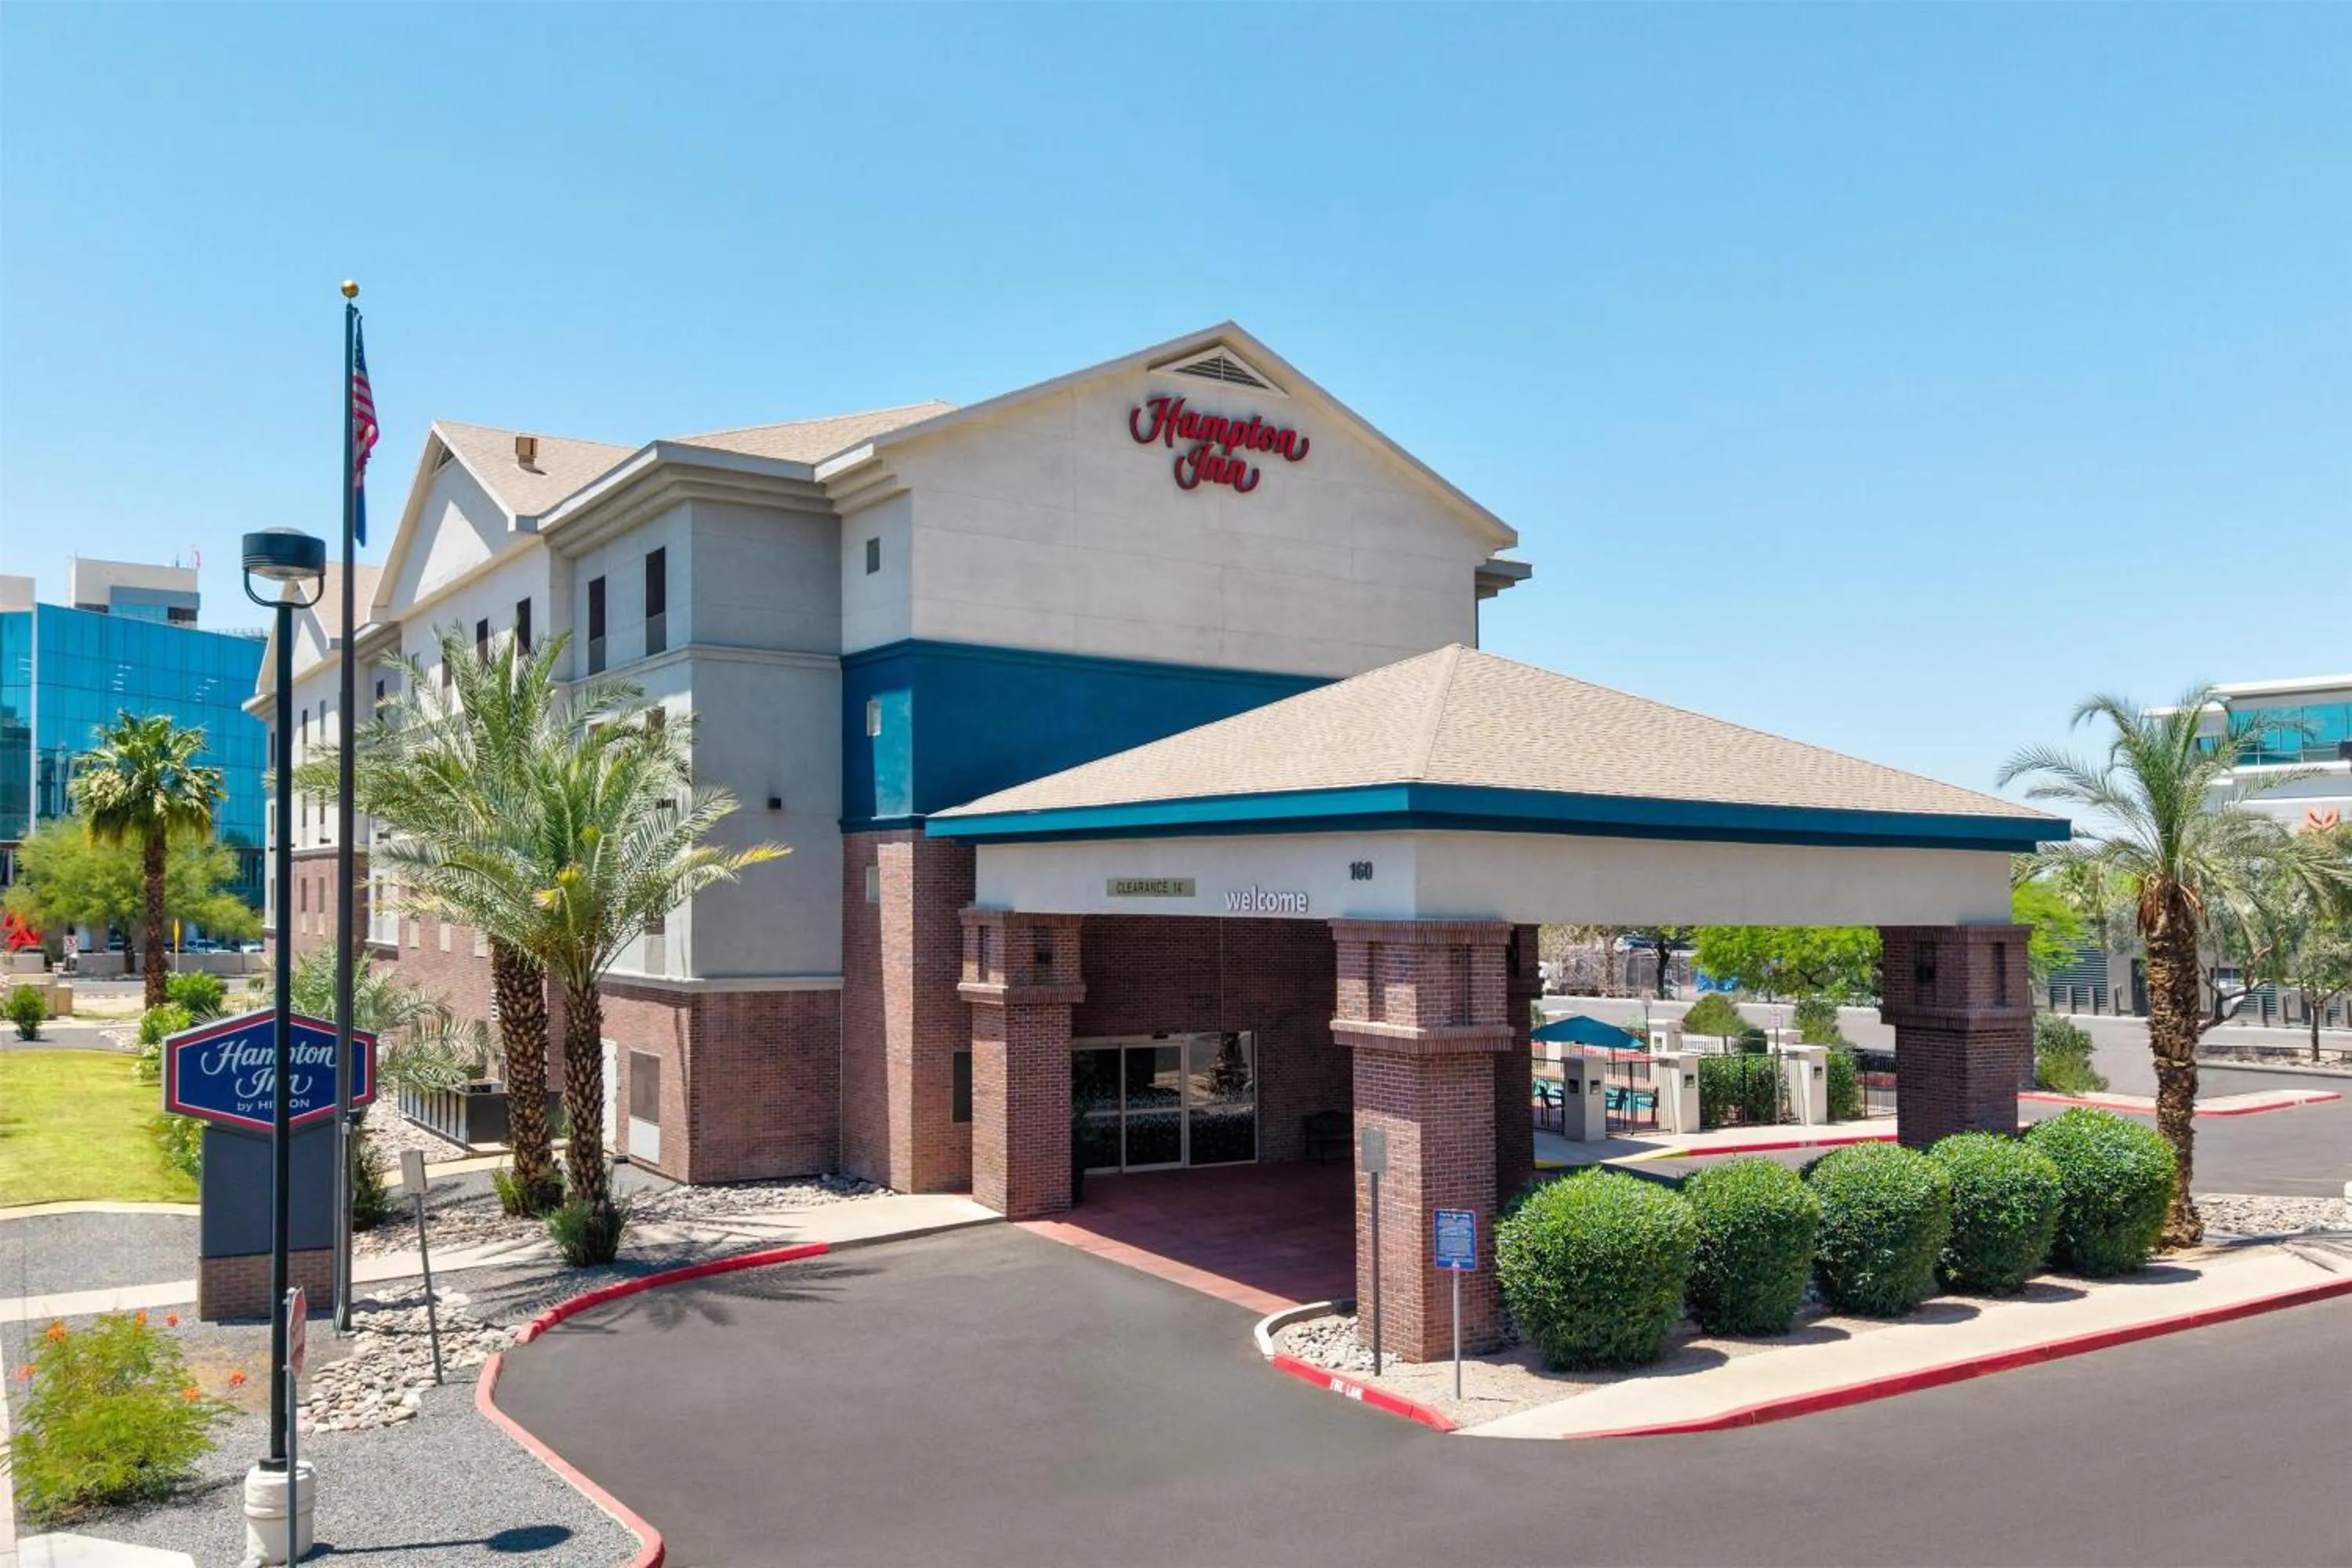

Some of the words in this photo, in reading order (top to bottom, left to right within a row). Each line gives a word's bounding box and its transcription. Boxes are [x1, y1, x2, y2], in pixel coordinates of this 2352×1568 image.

[1129, 396, 1310, 462] Hampton
[1174, 443, 1260, 493] Inn
[1348, 862, 1373, 880] 160
[1116, 880, 1167, 894] CLEARANCE
[1224, 885, 1308, 912] welcome
[238, 1101, 253, 1112] by
[258, 1098, 310, 1110] HION
